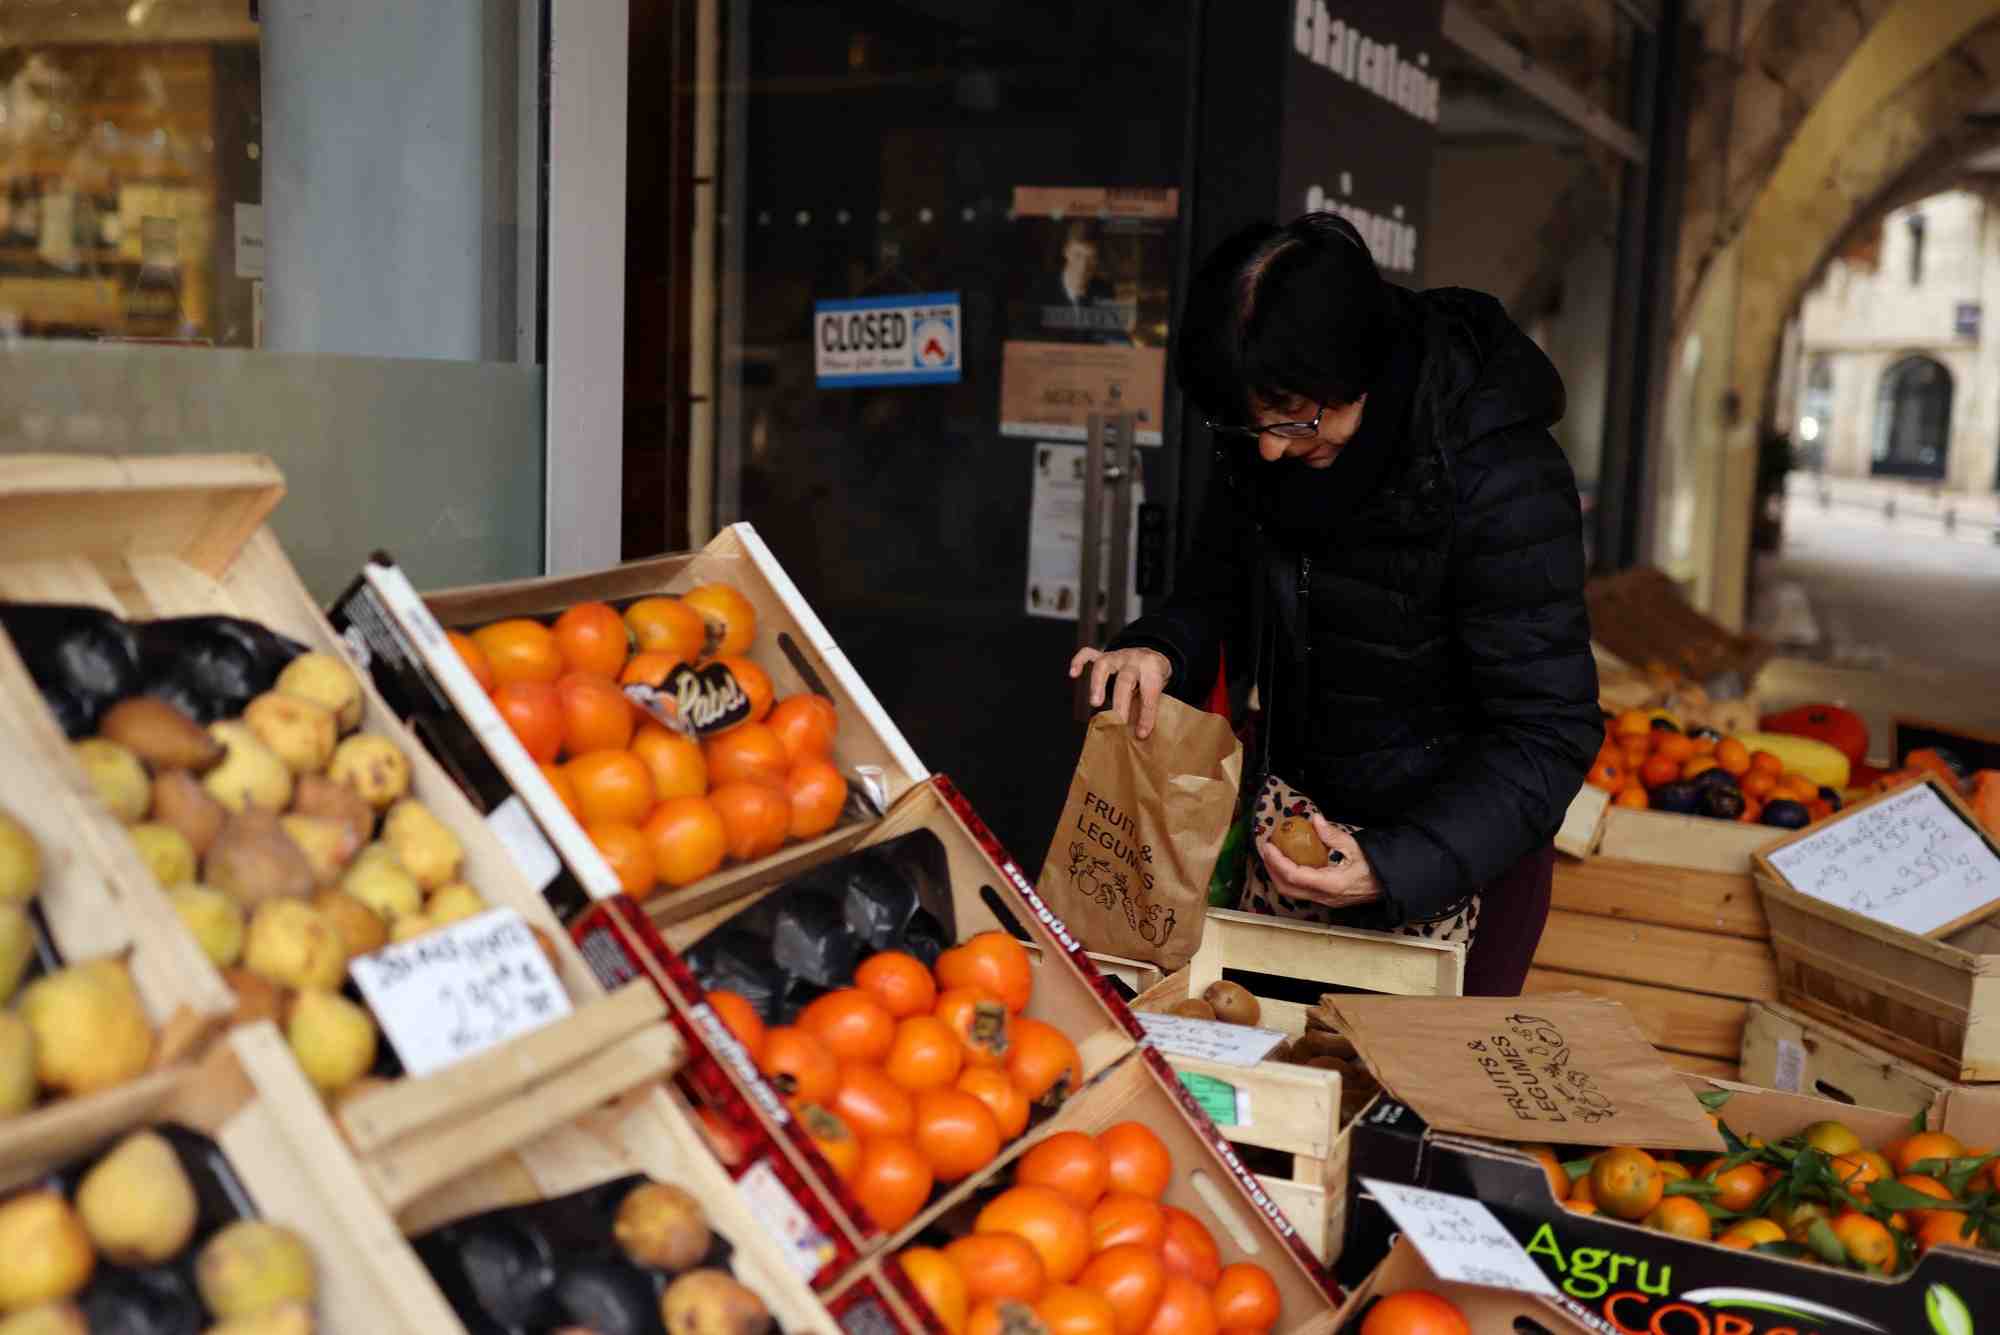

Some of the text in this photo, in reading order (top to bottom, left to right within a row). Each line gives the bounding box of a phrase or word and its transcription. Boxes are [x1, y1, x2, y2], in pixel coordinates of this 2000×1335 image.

[821, 312, 907, 352] CLOSED
[1139, 844, 1153, 864] &
[1466, 1038, 1537, 1121] FRUITS &
[1491, 1035, 1568, 1122] LEGUMES
[1526, 1222, 1672, 1298] Agru
